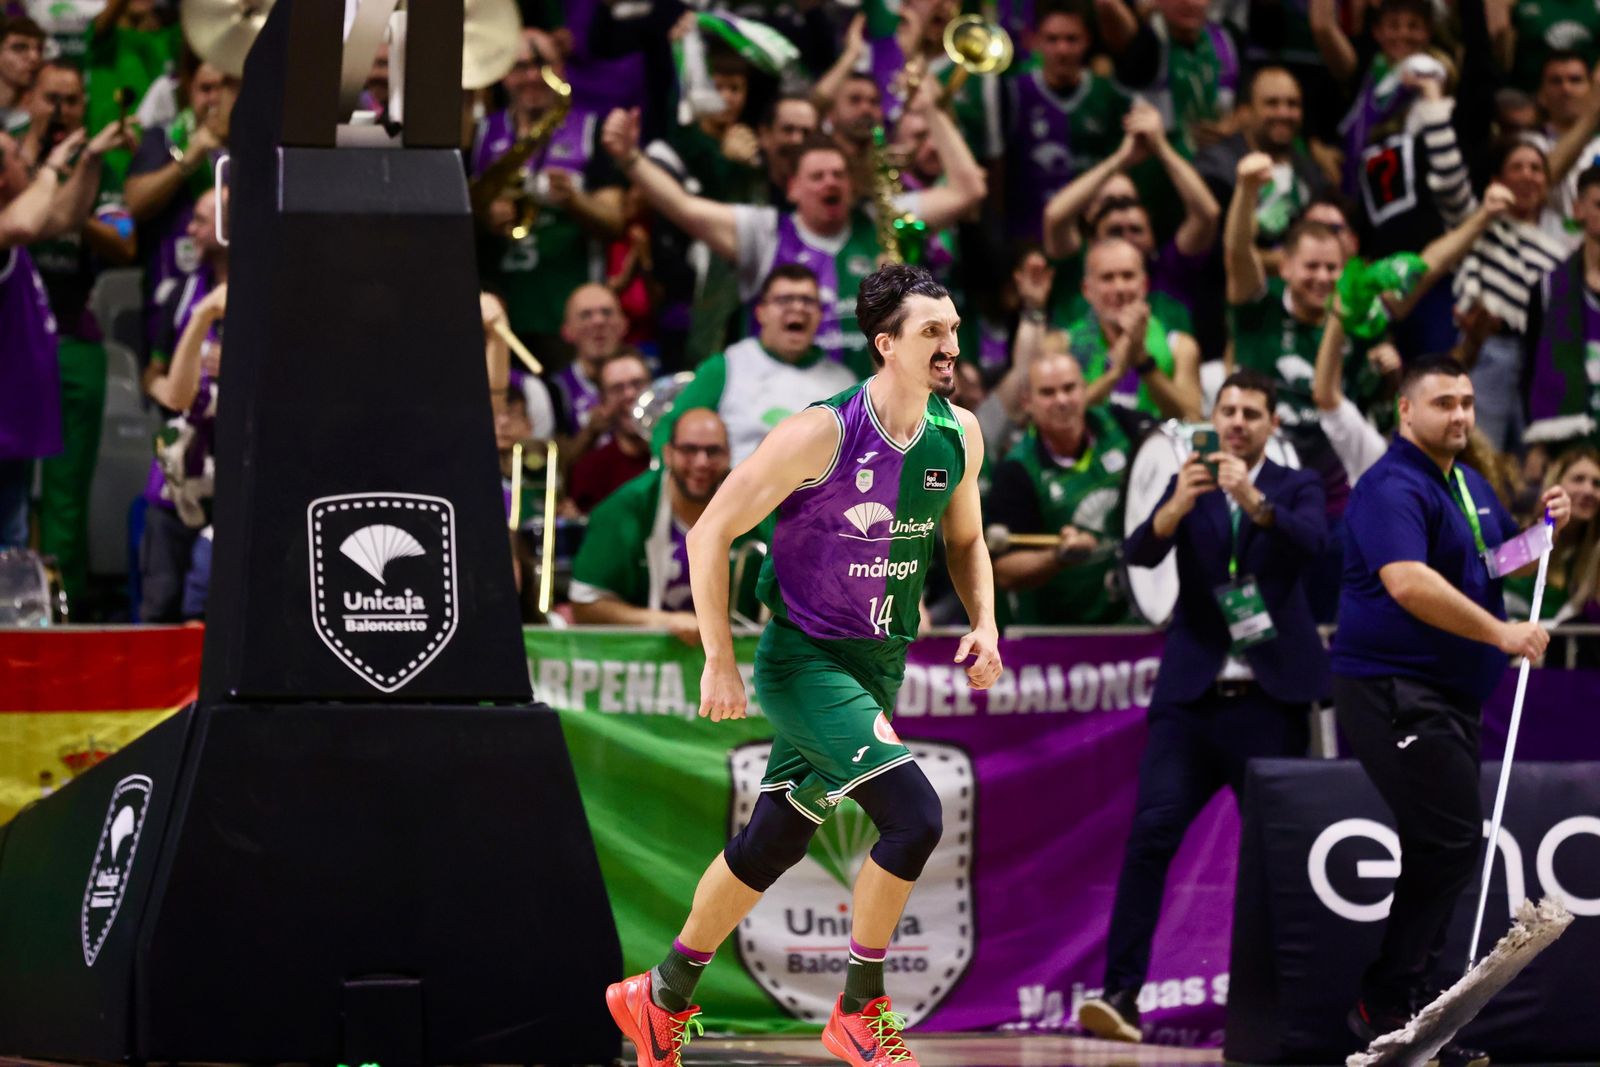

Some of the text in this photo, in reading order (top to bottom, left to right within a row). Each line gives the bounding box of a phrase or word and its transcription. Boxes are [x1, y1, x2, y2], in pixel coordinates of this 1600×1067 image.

[889, 517, 935, 536] Unicaja
[343, 588, 425, 614] Unicaja
[345, 619, 427, 632] Baloncesto
[869, 594, 895, 637] 14
[896, 663, 977, 717] DEL
[787, 952, 928, 975] Balosto
